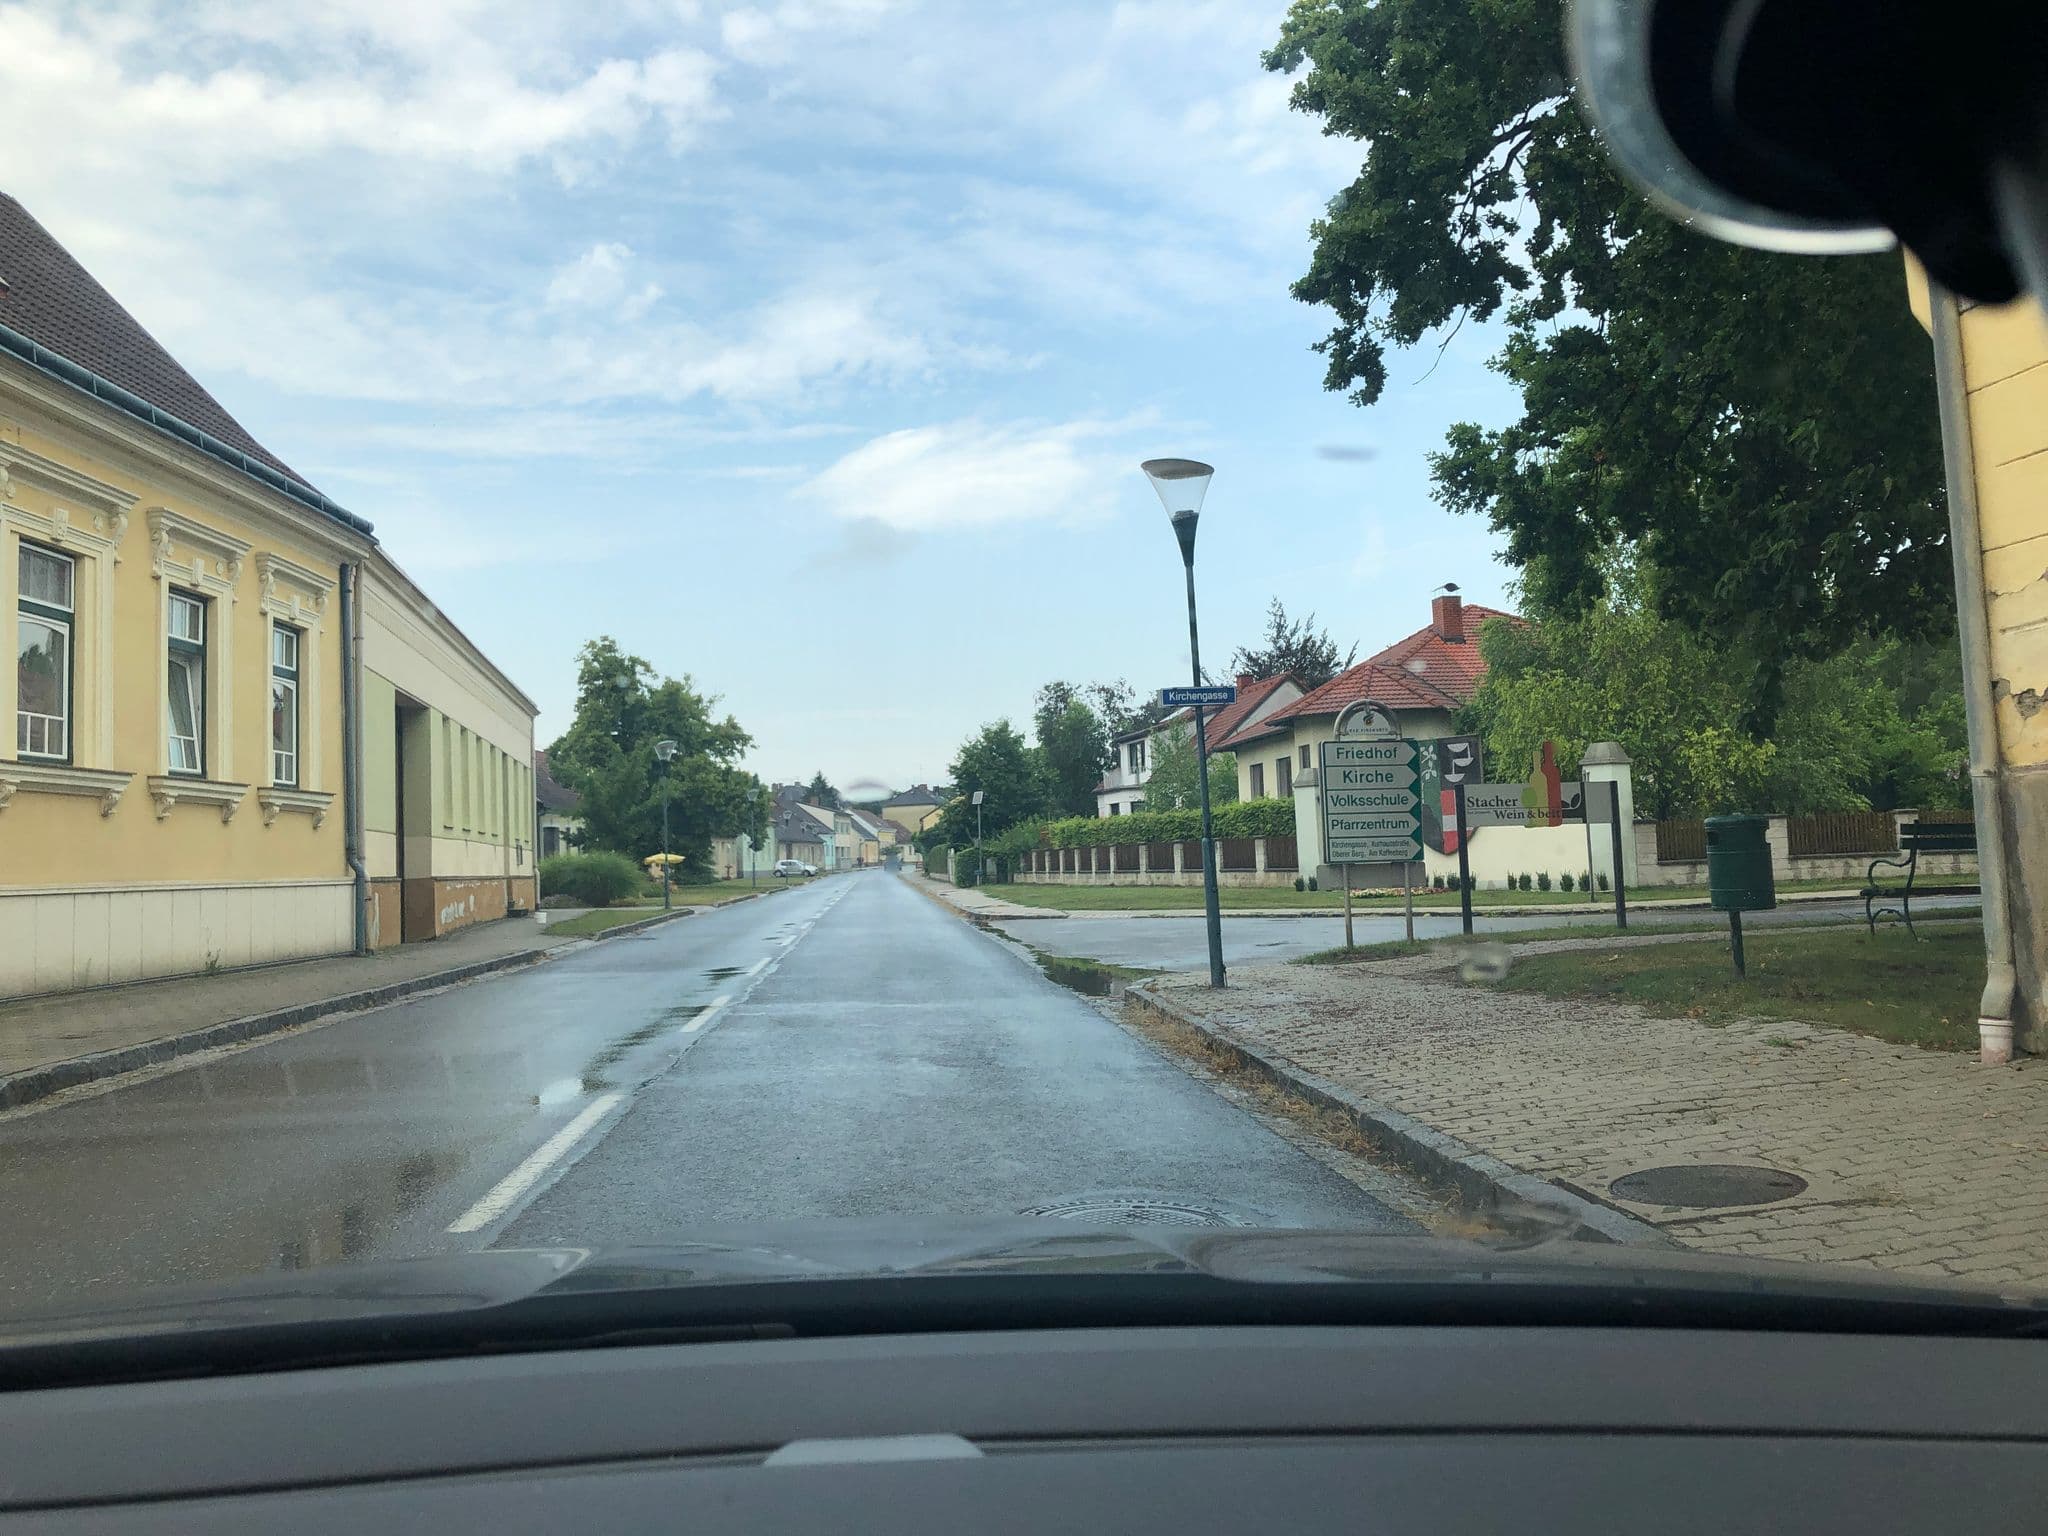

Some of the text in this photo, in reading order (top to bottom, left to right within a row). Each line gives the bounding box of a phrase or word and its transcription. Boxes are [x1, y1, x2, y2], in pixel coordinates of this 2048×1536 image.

[1169, 691, 1228, 702] Kirchengasse
[1336, 747, 1398, 759] Friedhof
[1343, 770, 1394, 784] Kirche
[1330, 794, 1409, 807] Volksschule
[1467, 795, 1519, 808] Stacher
[1493, 808, 1525, 820] Wein
[1527, 810, 1536, 820] &
[1331, 819, 1410, 830] Pfarrzentrum
